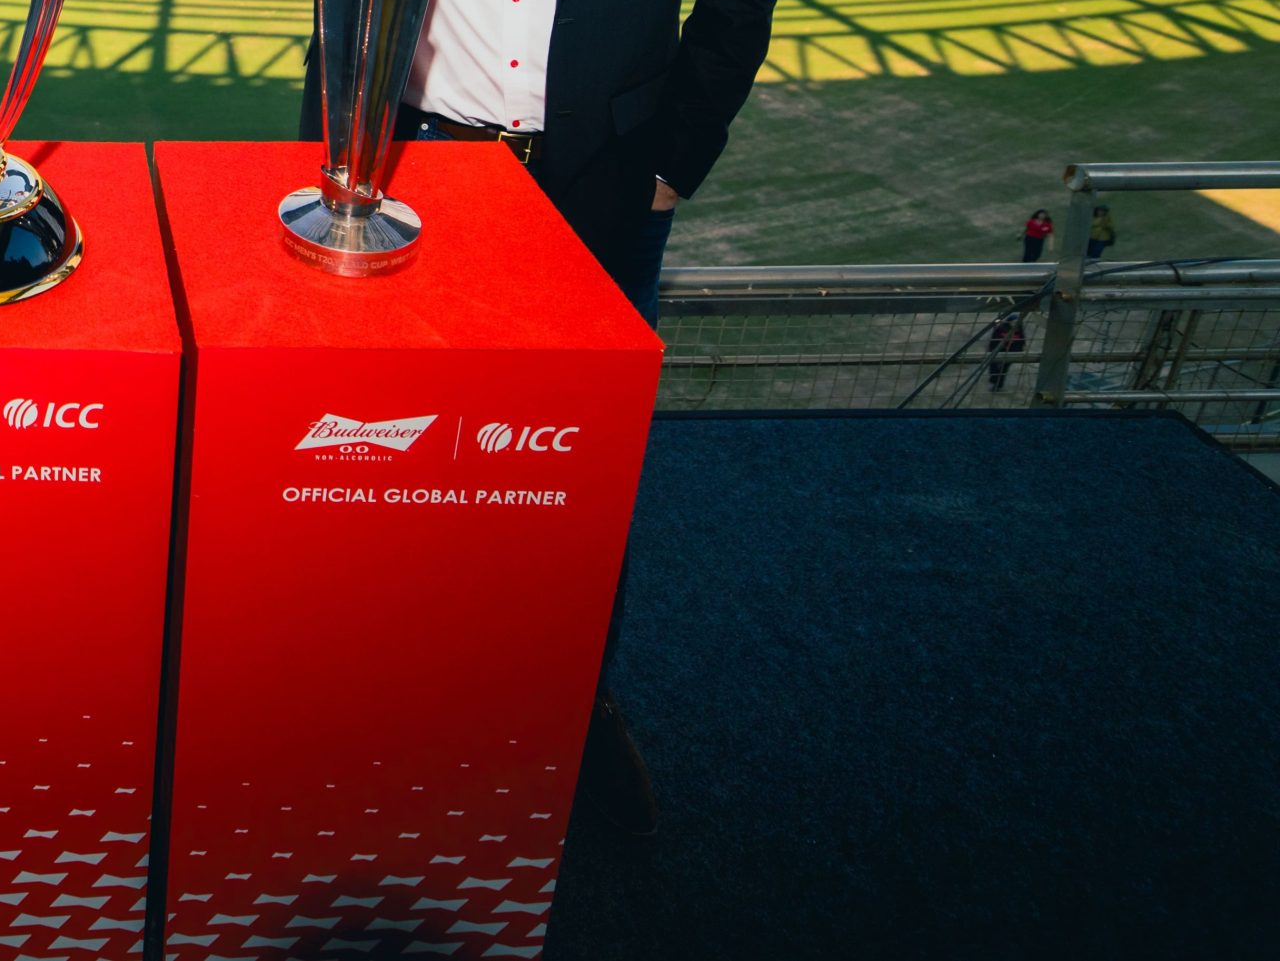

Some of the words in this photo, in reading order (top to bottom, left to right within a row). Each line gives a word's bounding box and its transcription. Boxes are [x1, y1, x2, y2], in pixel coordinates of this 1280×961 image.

[43, 403, 104, 429] ICC
[308, 420, 423, 439] Budweiser
[515, 426, 580, 452] ICC
[315, 454, 393, 462] NON-ALCOHOLIC
[339, 445, 369, 454] 0.0
[11, 466, 101, 483] PARTNER
[282, 487, 377, 503] OFFICIAL
[383, 488, 469, 504] GLOBAL
[475, 490, 567, 506] PARTNER
